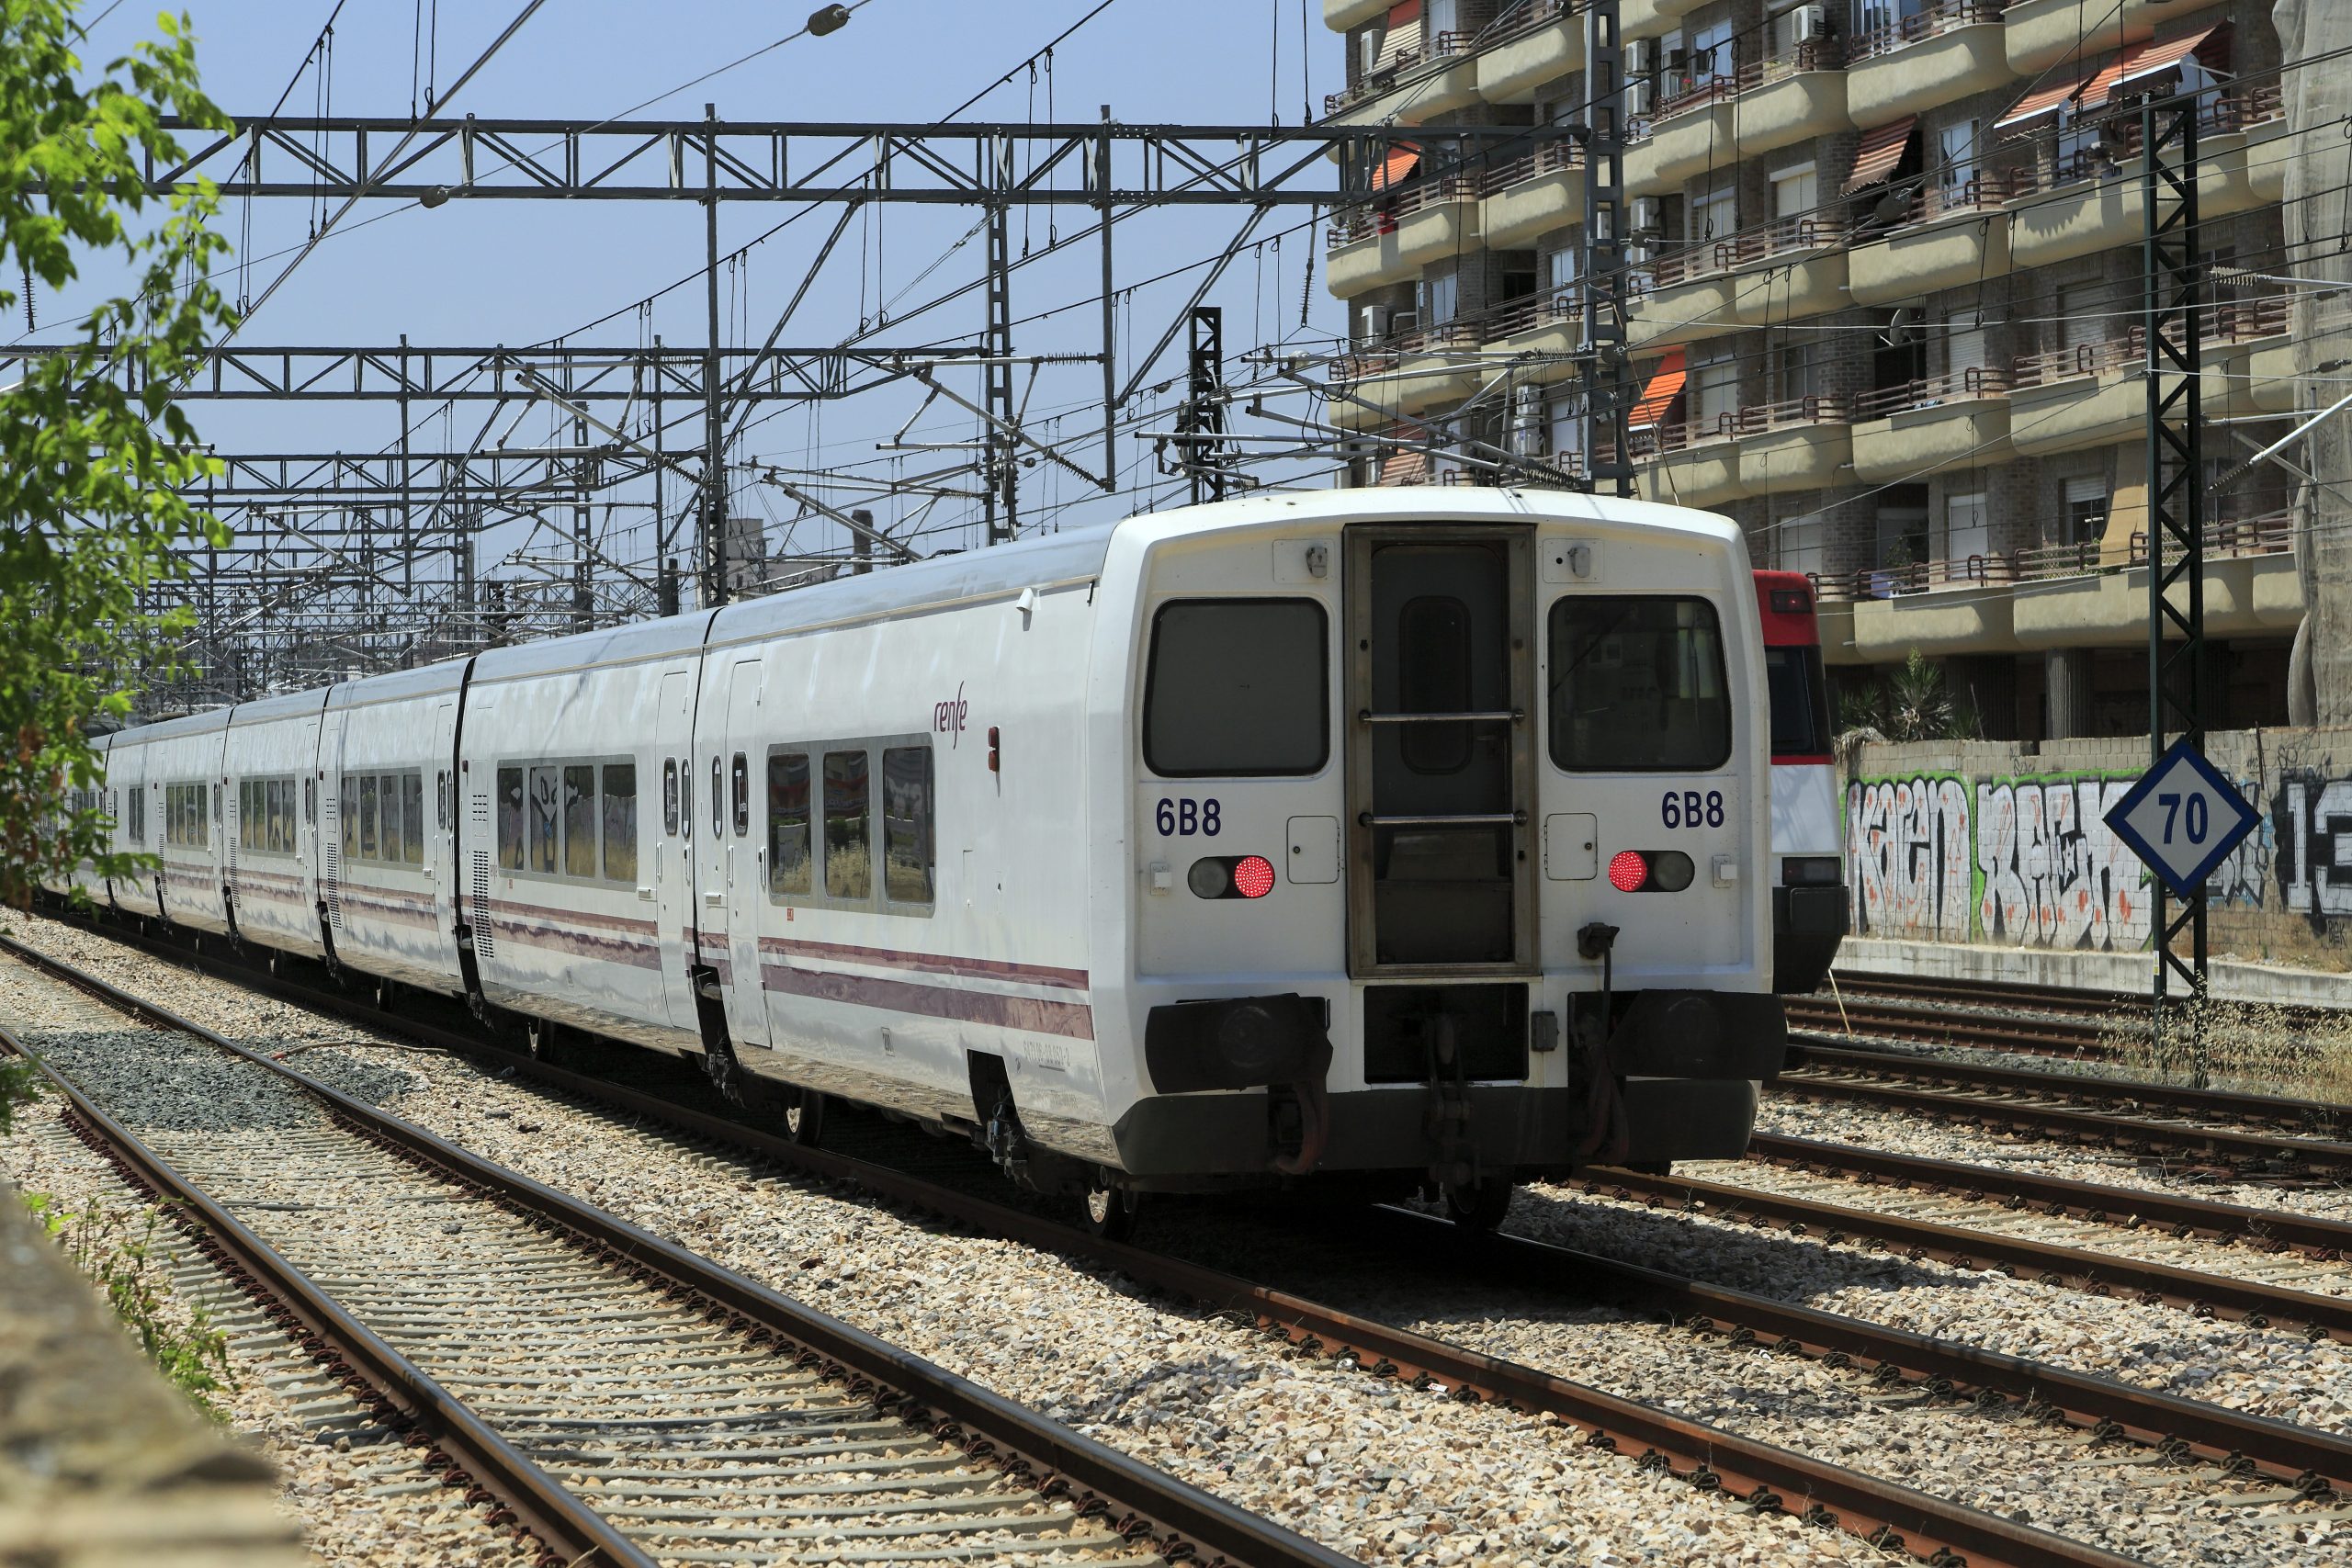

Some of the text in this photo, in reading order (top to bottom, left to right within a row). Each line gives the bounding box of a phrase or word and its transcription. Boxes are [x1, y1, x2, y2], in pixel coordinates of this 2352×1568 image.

[933, 680, 967, 750] renfe
[1156, 797, 1221, 837] 6B8
[1661, 790, 1724, 829] 6B8
[2158, 792, 2209, 845] 70
